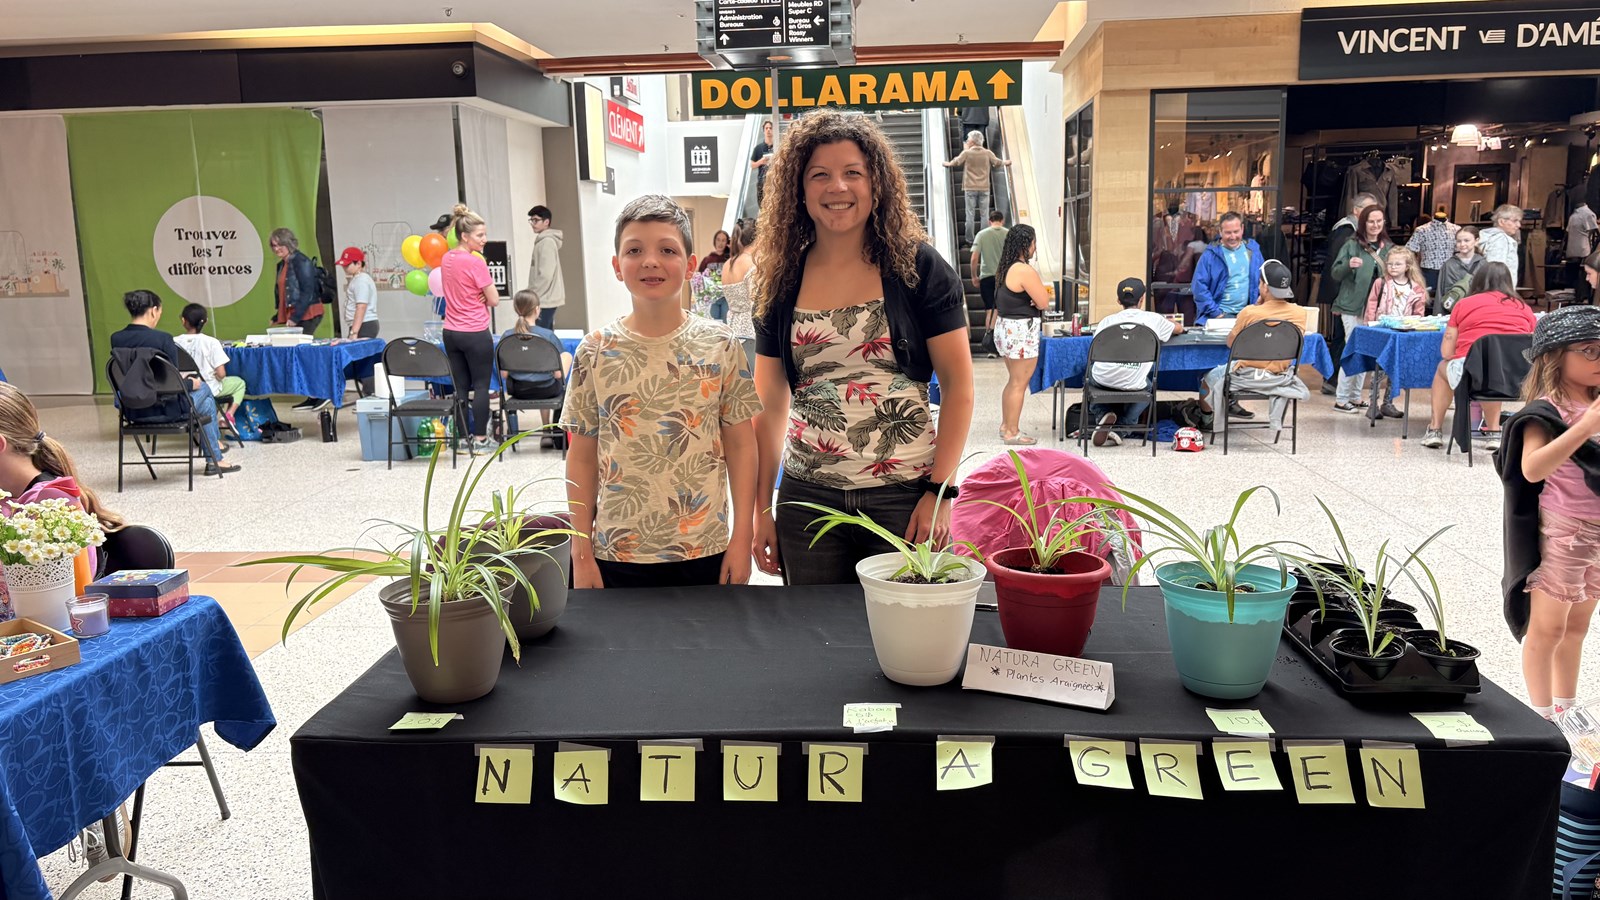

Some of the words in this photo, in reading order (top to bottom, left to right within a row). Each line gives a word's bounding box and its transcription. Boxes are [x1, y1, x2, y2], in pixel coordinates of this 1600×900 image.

[719, 13, 763, 21] Administration
[1338, 26, 1466, 54] VINCENT
[701, 69, 980, 109] DOLLARAMA
[608, 106, 638, 145] CLÉMENT
[174, 228, 237, 241] Trouvez
[192, 245, 212, 258] les
[215, 245, 223, 257] 7
[168, 262, 252, 276] différences
[980, 646, 1040, 668] NATURA
[1053, 658, 1102, 678] GREEN
[1006, 668, 1045, 684] Plantes
[1227, 716, 1264, 727] 10$
